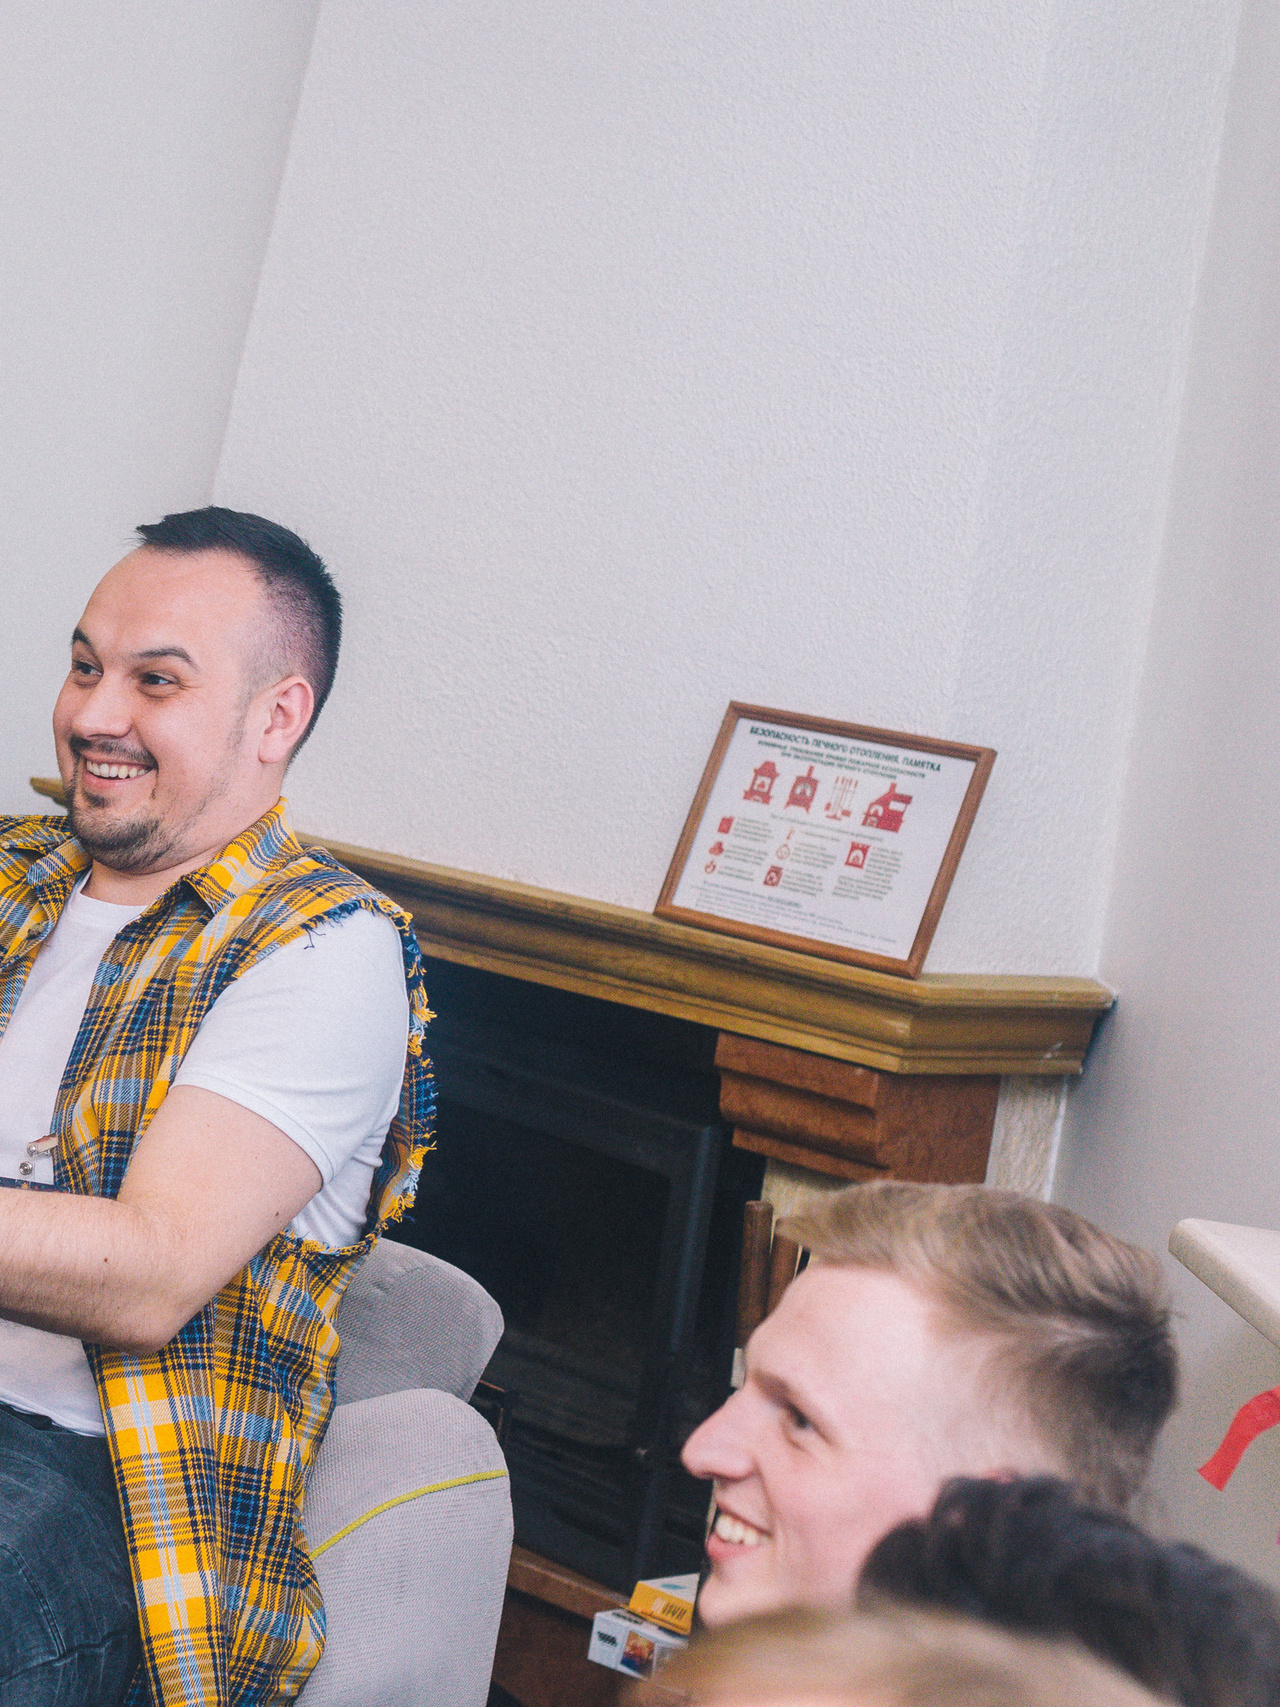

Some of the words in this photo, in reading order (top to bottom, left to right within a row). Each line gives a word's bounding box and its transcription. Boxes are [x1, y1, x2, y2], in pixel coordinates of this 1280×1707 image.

[750, 726, 810, 746] БЕЗОПАСНОСТЬ
[811, 738, 848, 753] ПЕЧНОГО
[902, 758, 941, 773] ПАМЯТКА
